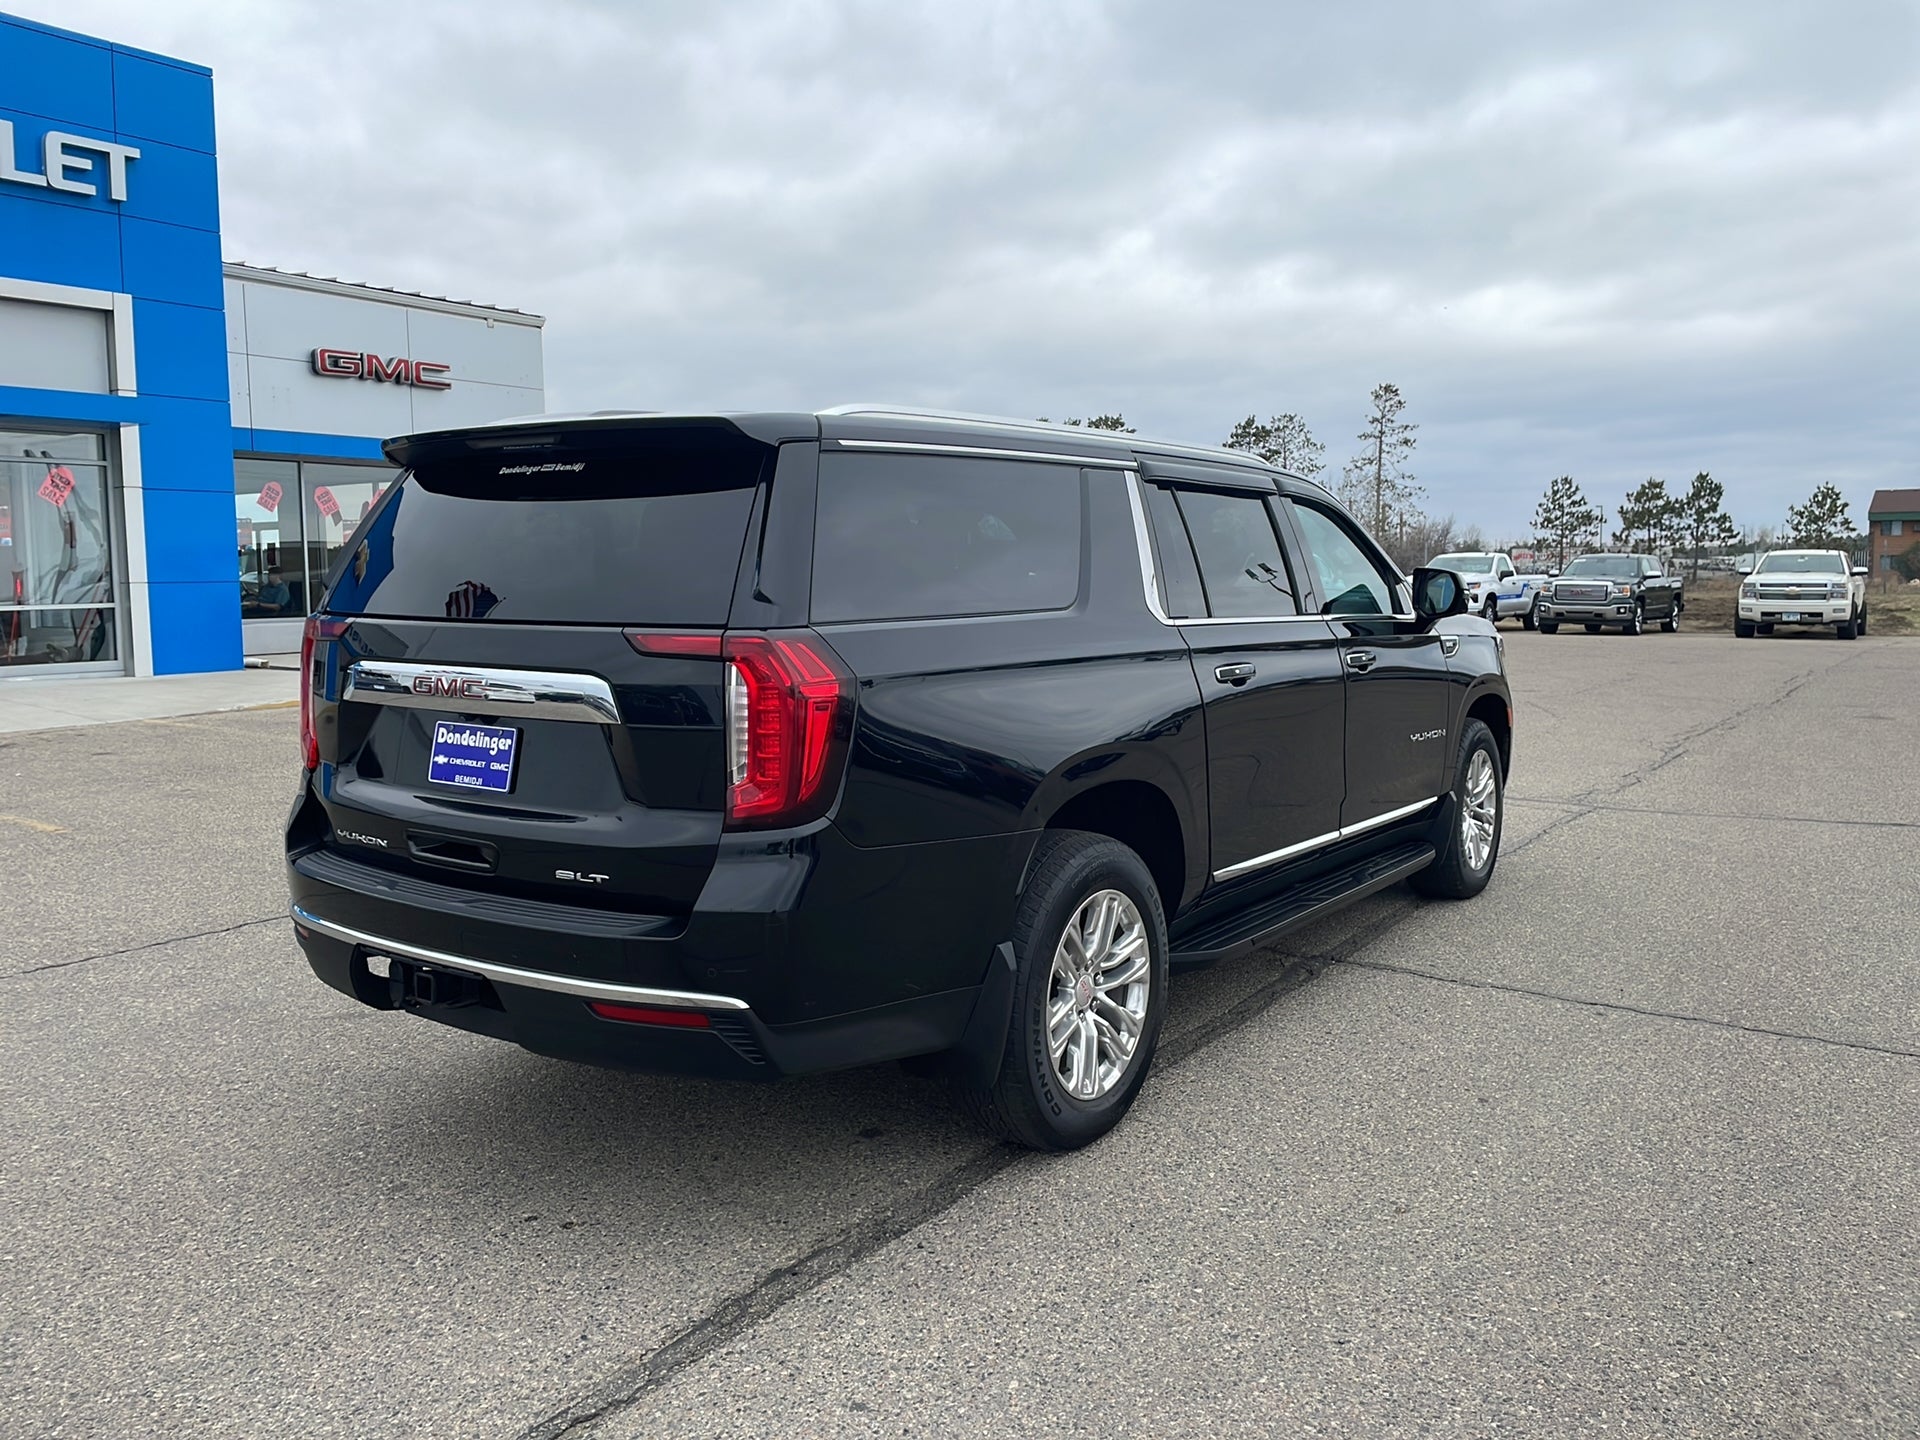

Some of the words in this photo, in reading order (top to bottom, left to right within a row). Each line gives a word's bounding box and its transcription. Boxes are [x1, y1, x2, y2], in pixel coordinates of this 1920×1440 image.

[0, 119, 141, 201] LET
[311, 347, 452, 390] GMC
[499, 465, 541, 475] Dondelinger
[40, 486, 65, 505] SALE
[413, 675, 483, 698] GMC
[437, 727, 512, 756] Dondelinger
[1410, 728, 1446, 742] YUKON
[449, 757, 486, 768] CHEVROLET
[490, 762, 510, 772] GMC
[454, 774, 483, 786] BEMIDJI
[337, 829, 388, 848] YUKON
[555, 869, 610, 884] SLT
